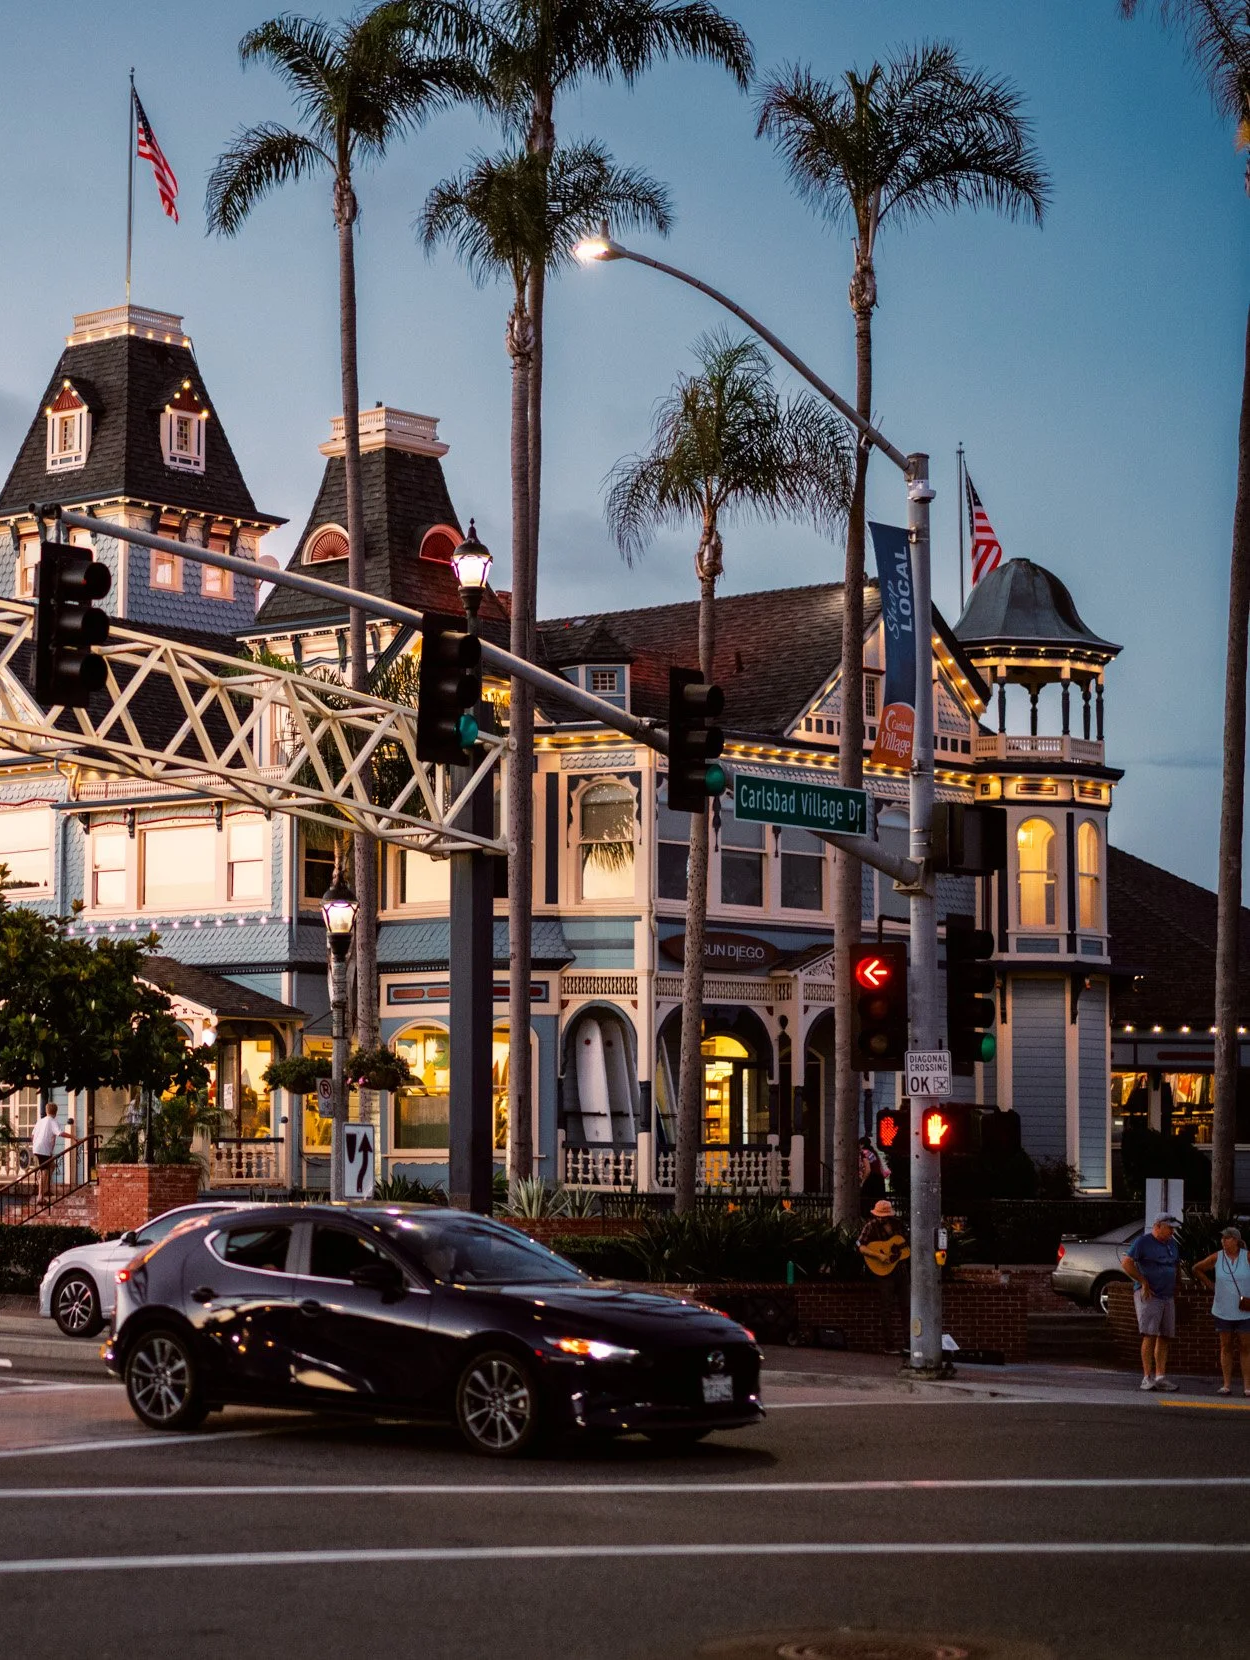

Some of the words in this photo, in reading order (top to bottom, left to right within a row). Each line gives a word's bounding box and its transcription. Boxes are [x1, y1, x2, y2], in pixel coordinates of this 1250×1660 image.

[894, 546, 913, 632] LOCAL
[886, 580, 900, 640] Shop
[880, 731, 911, 758] Village
[740, 784, 795, 813] Carlsbad
[801, 792, 843, 825] Village
[848, 799, 862, 822] Dr
[910, 1054, 948, 1063] DIAGONAL
[910, 1063, 948, 1072] CROSSING
[910, 1076, 930, 1094] OK
